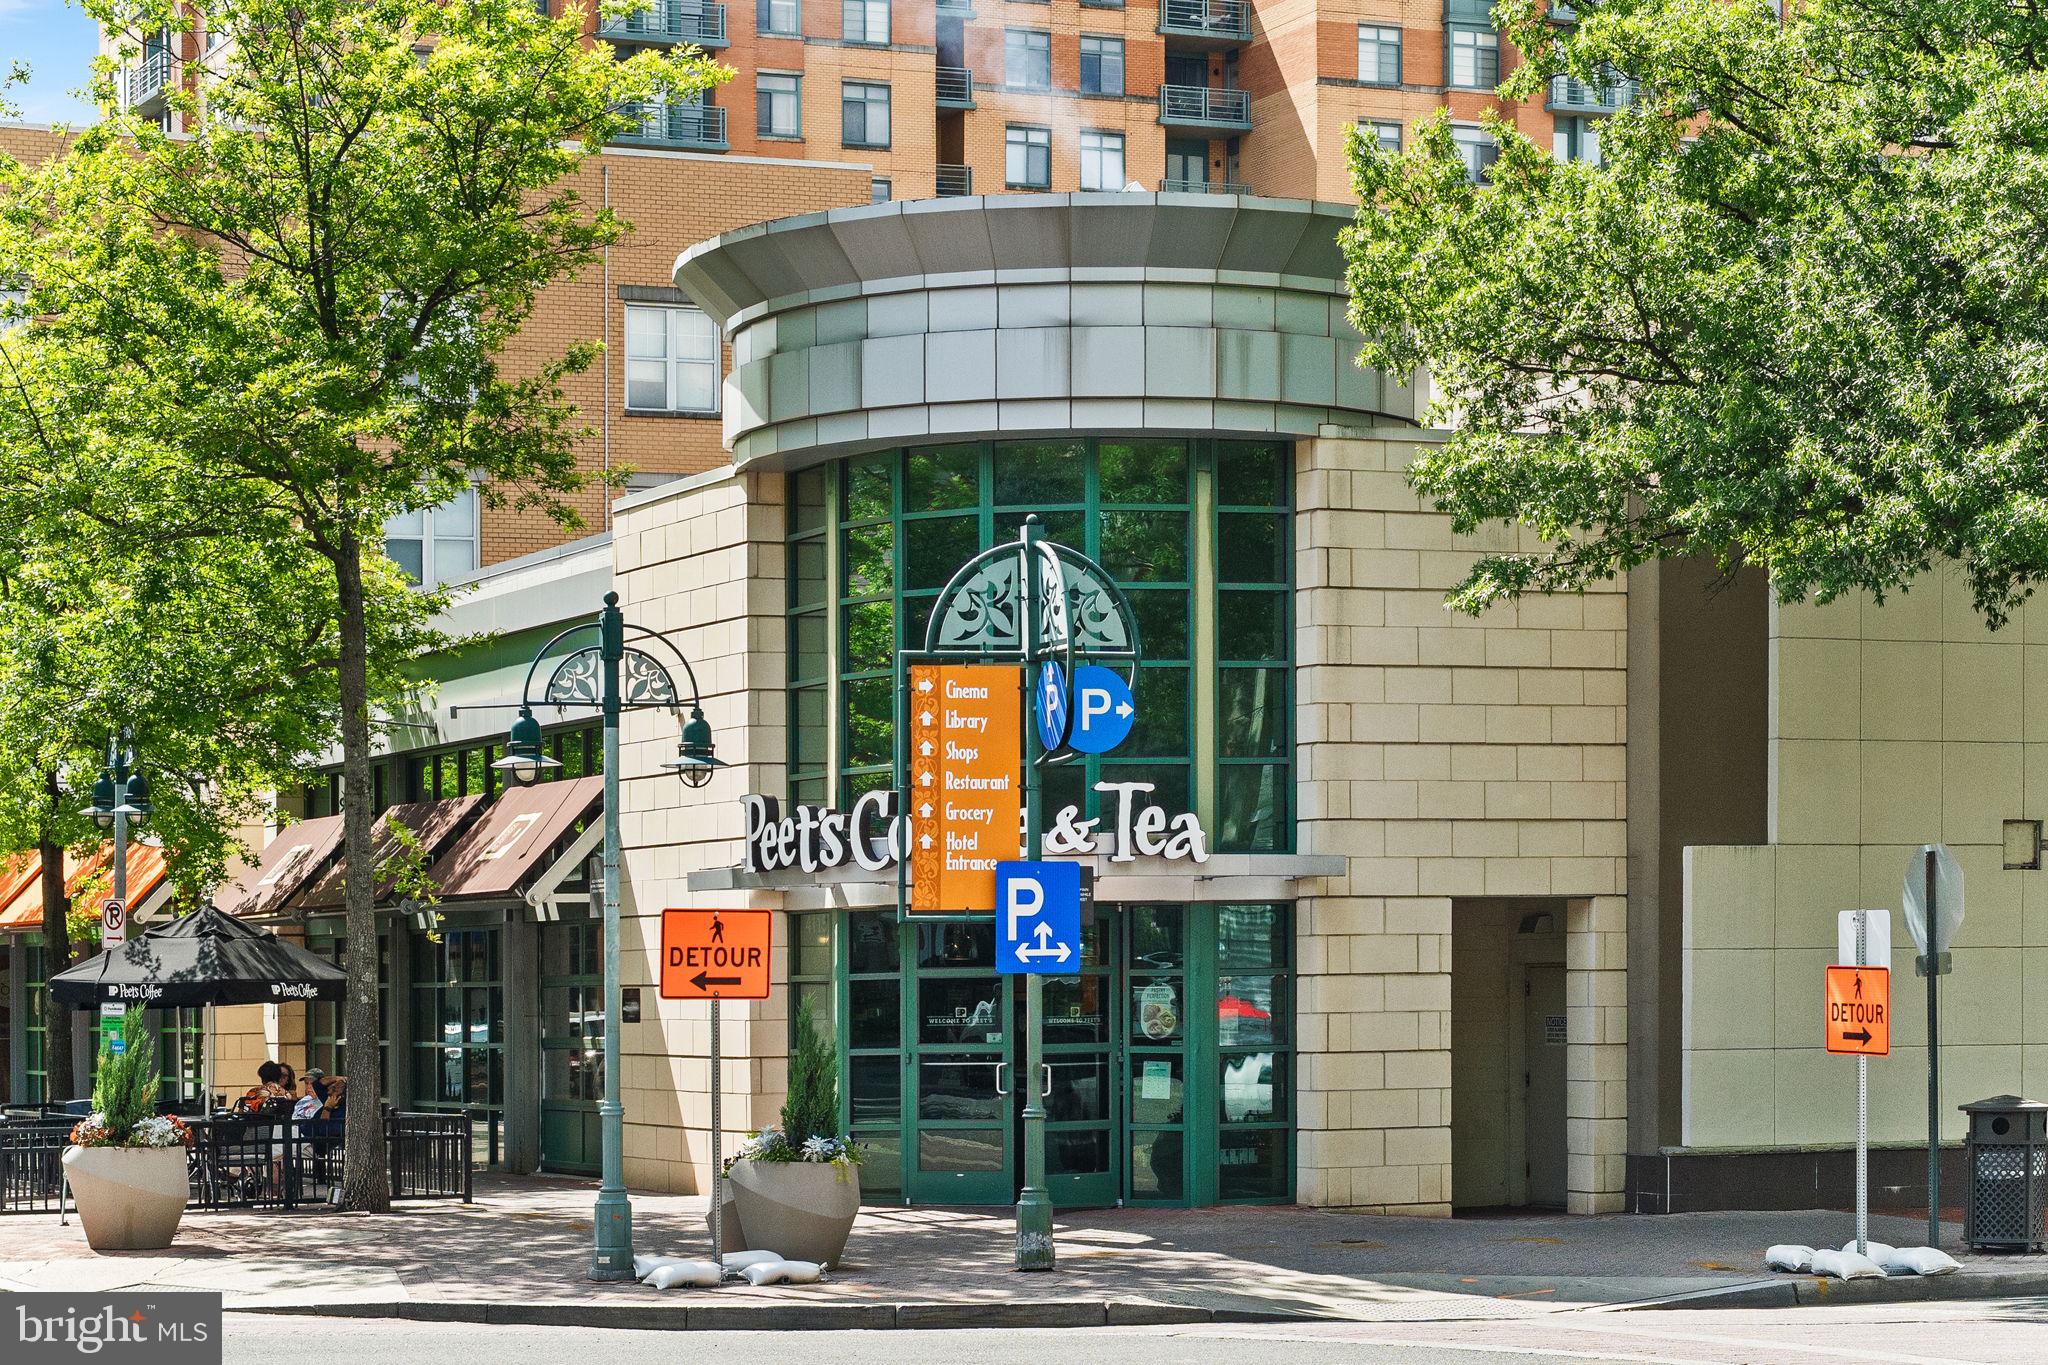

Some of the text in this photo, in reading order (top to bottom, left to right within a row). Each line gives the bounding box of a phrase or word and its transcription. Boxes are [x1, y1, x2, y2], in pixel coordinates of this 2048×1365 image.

[946, 680, 988, 699] Cinema
[1082, 688, 1112, 731] P
[945, 711, 988, 733] Library
[946, 741, 979, 764] Shops
[945, 771, 1010, 790] Restaurant
[946, 802, 994, 824] Grocery
[740, 794, 845, 874] Peet's
[1045, 804, 1100, 853] &
[1094, 781, 1210, 863] Tea
[946, 831, 978, 850] Hotel
[946, 852, 997, 871] Entrance
[1007, 877, 1045, 941] P
[670, 946, 761, 968] DETOUR
[119, 983, 163, 999] Peet's Coffee
[280, 982, 318, 998] Peet's Coffee
[928, 1017, 960, 1025] WELCOME
[962, 1017, 971, 1025] TO
[1831, 1002, 1884, 1024] DETOUR
